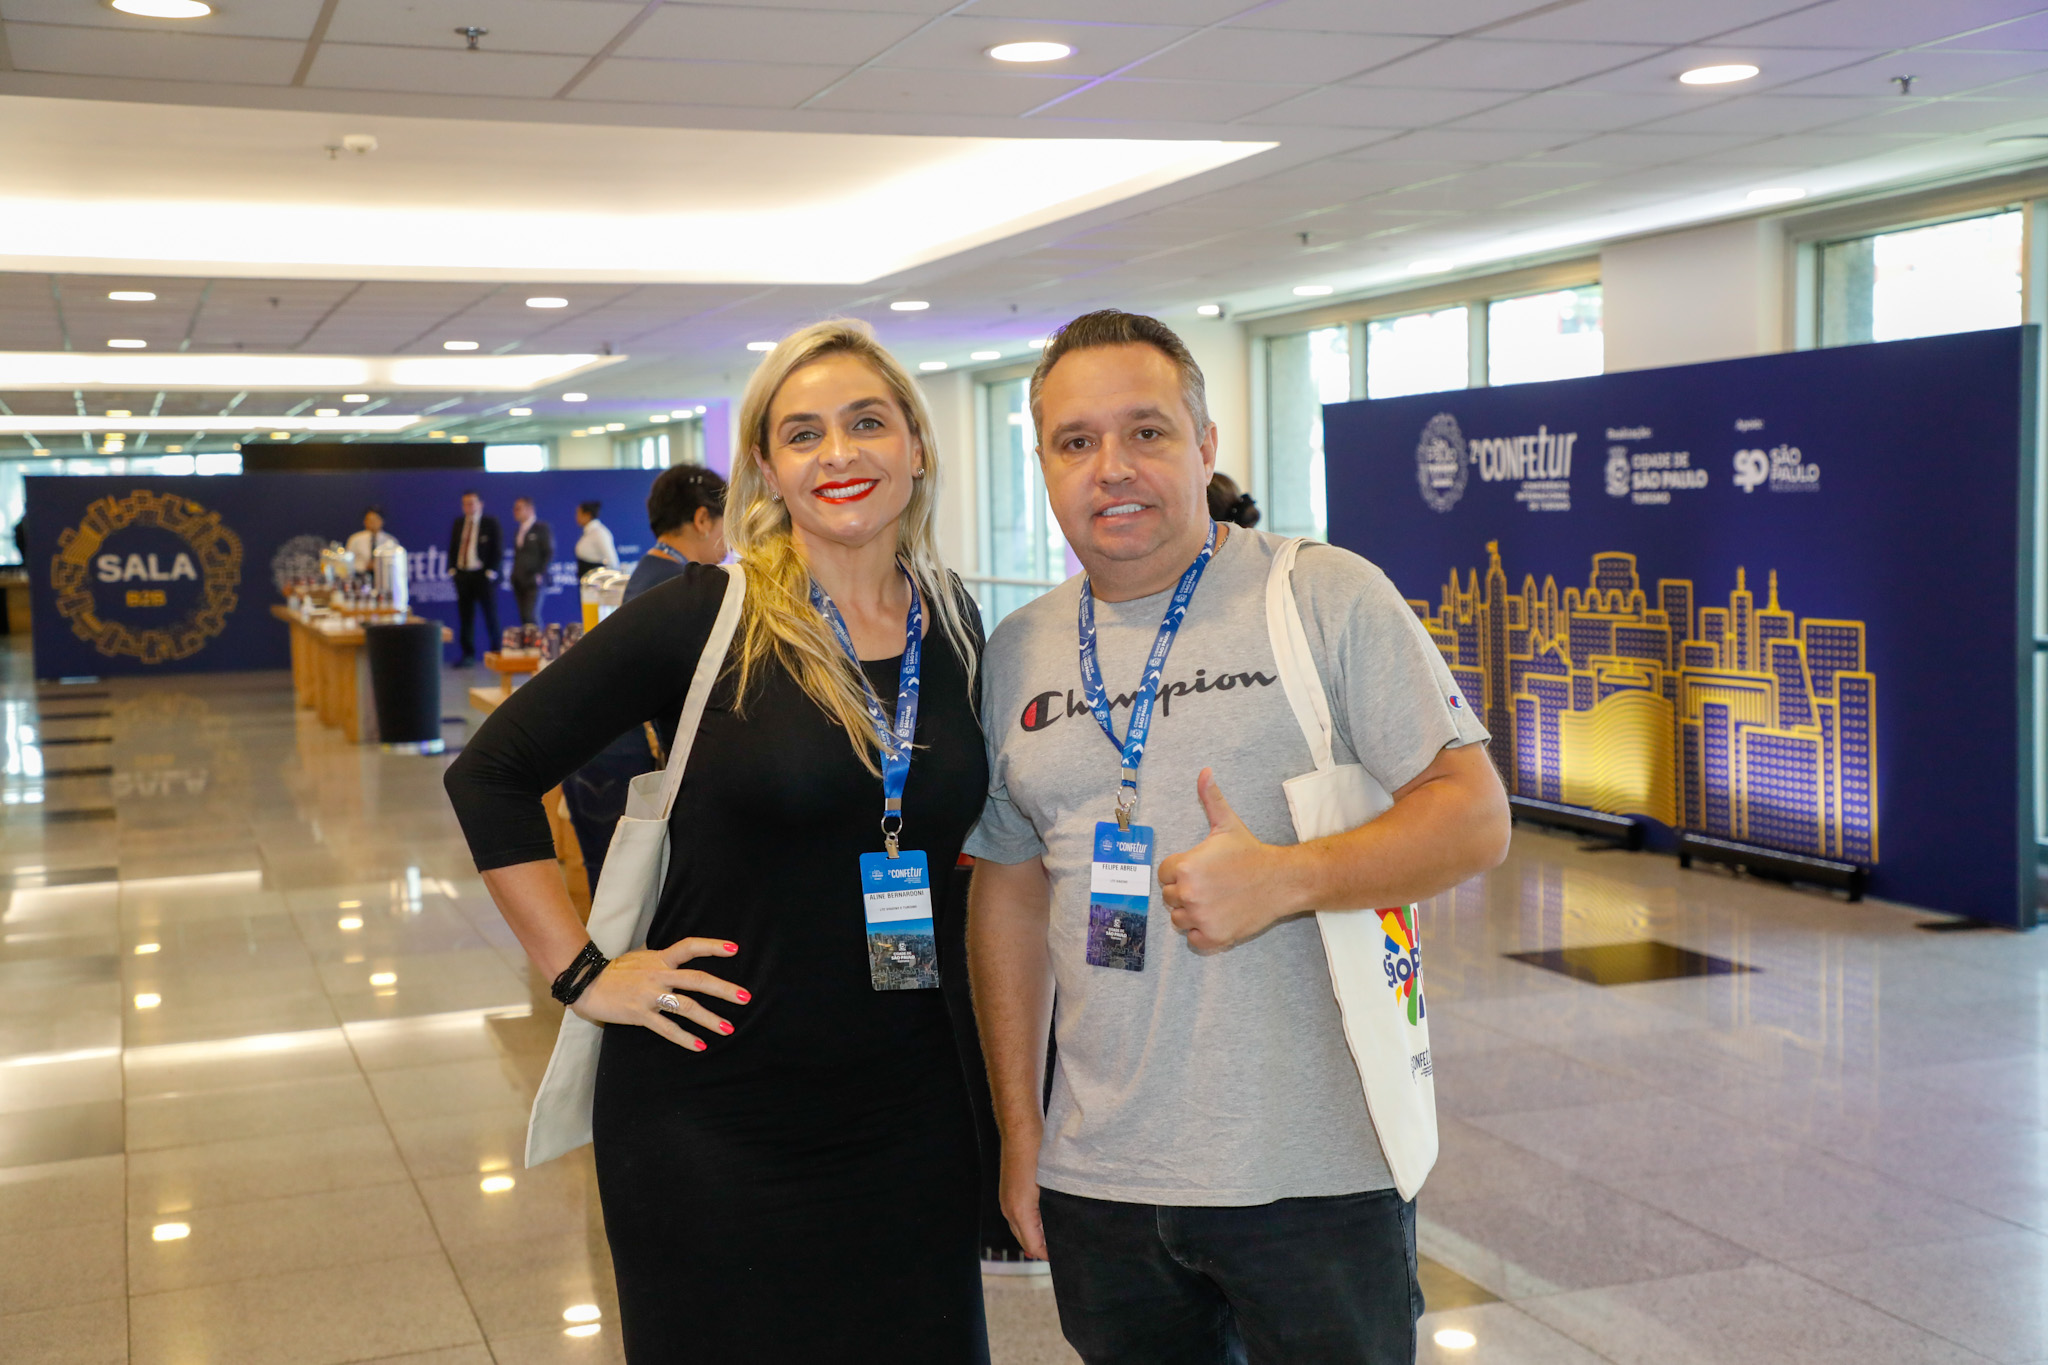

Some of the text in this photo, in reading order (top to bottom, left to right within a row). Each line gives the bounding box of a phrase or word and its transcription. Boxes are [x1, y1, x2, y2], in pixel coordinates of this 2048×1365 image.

[1632, 452, 1690, 470] CIDADE DE
[1661, 468, 1709, 490] PAULO
[1769, 463, 1820, 482] PAULO
[97, 553, 197, 582] SALA
[1021, 669, 1278, 732] Chmpion
[1102, 863, 1118, 871] FELIPE
